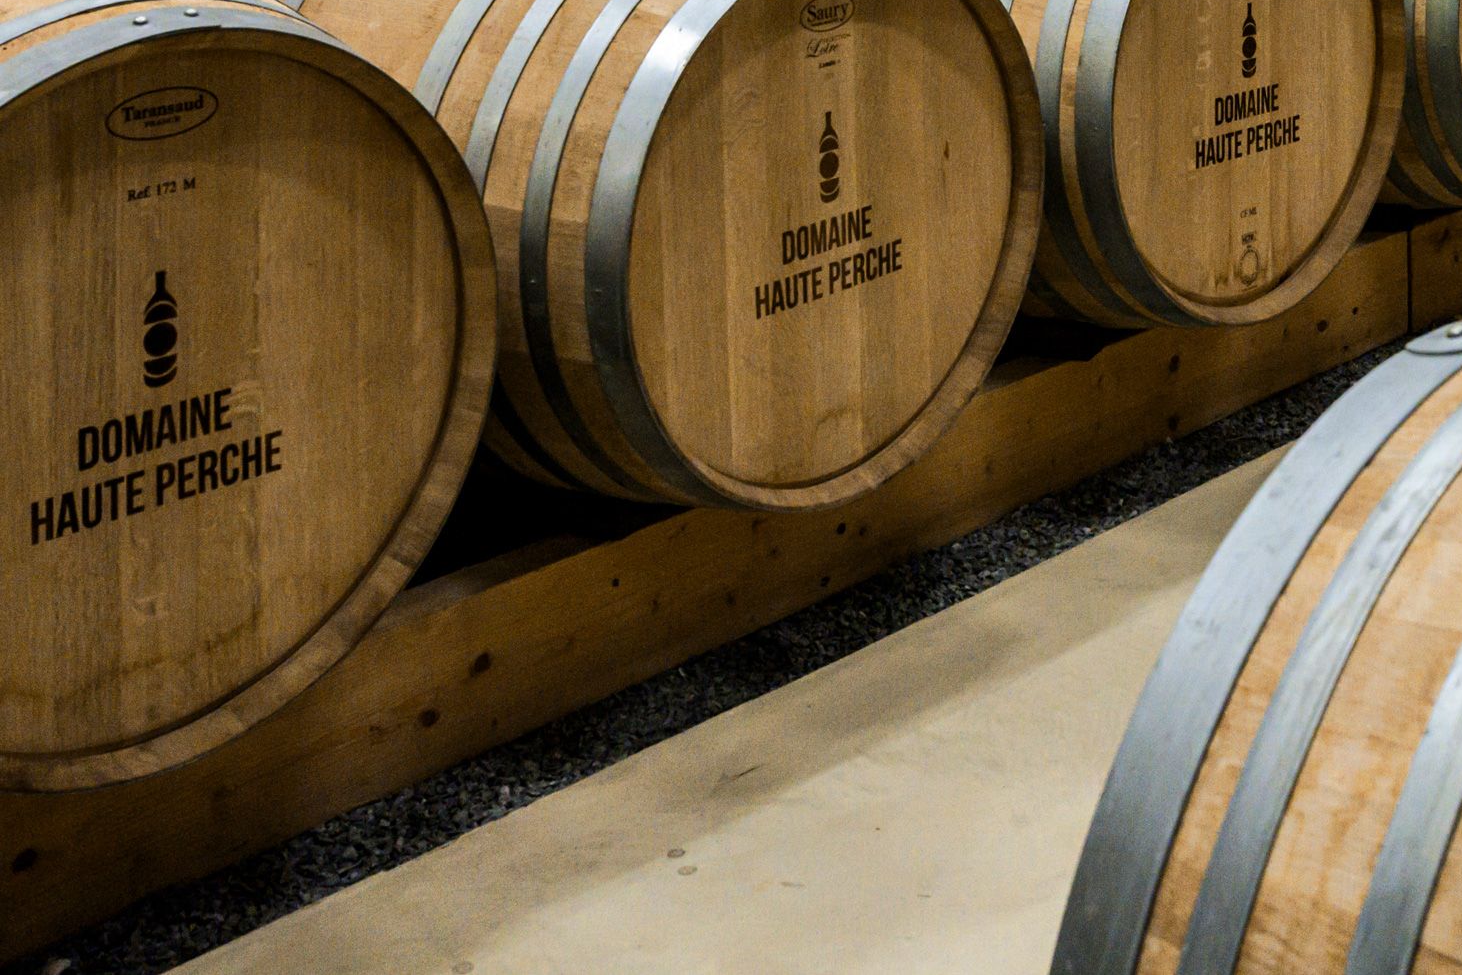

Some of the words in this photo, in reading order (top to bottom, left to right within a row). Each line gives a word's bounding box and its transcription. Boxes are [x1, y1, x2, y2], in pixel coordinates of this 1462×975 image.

[806, 3, 849, 23] Saury
[122, 94, 205, 122] Taransaud
[1214, 83, 1280, 127] DOMAINE
[1195, 129, 1243, 170] HAUTE
[1246, 114, 1301, 156] PERCHE
[156, 181, 177, 196] 172
[183, 177, 196, 191] M
[782, 204, 873, 266] DOMAINE
[754, 266, 824, 320] HAUTE
[828, 238, 903, 295] PERCHE
[77, 387, 233, 472] DOMAINE
[30, 469, 145, 546] HAUTE
[156, 430, 283, 507] PERCHE
